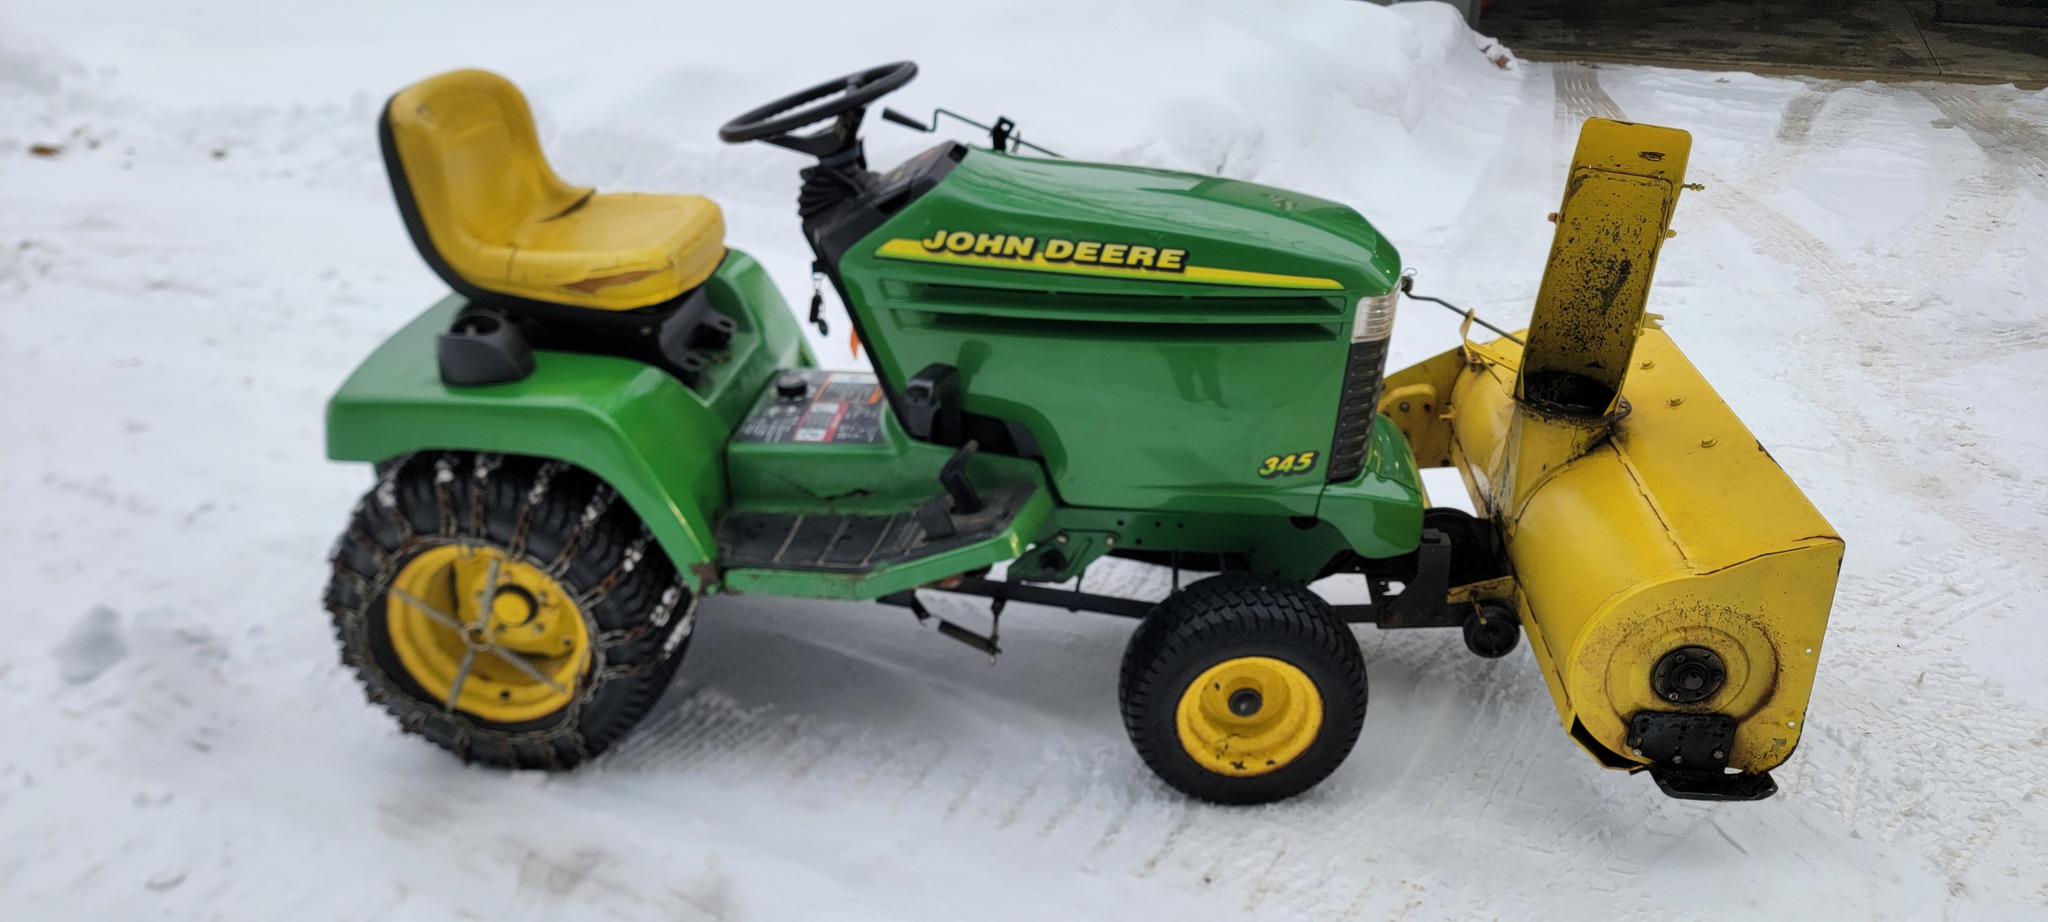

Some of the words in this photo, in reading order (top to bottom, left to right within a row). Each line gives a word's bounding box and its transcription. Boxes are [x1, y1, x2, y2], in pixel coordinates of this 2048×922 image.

[922, 230, 1036, 258] JOHN
[1043, 238, 1187, 270] DEERE
[1258, 451, 1316, 477] 345
